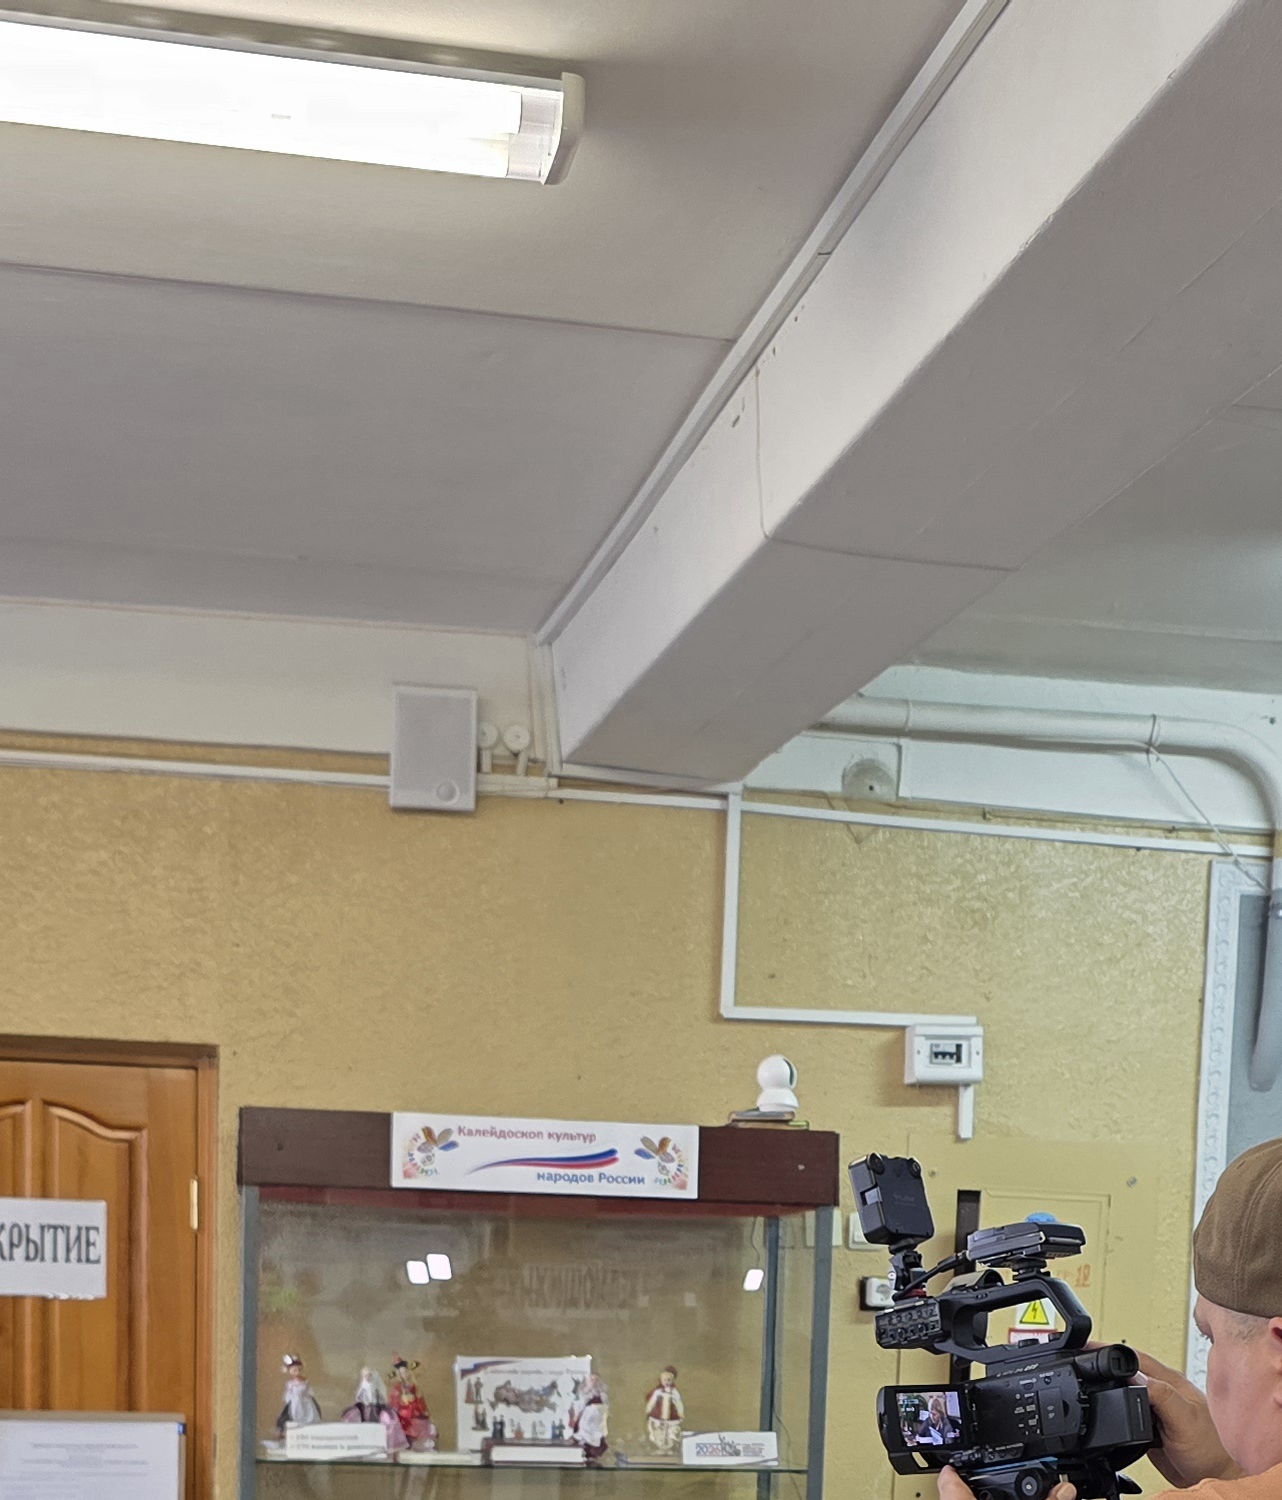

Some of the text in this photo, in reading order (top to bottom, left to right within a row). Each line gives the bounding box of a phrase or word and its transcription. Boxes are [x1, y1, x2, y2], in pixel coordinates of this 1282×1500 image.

[458, 1125, 597, 1144] Калейдоскоп культур
[537, 1172, 645, 1185] народов России
